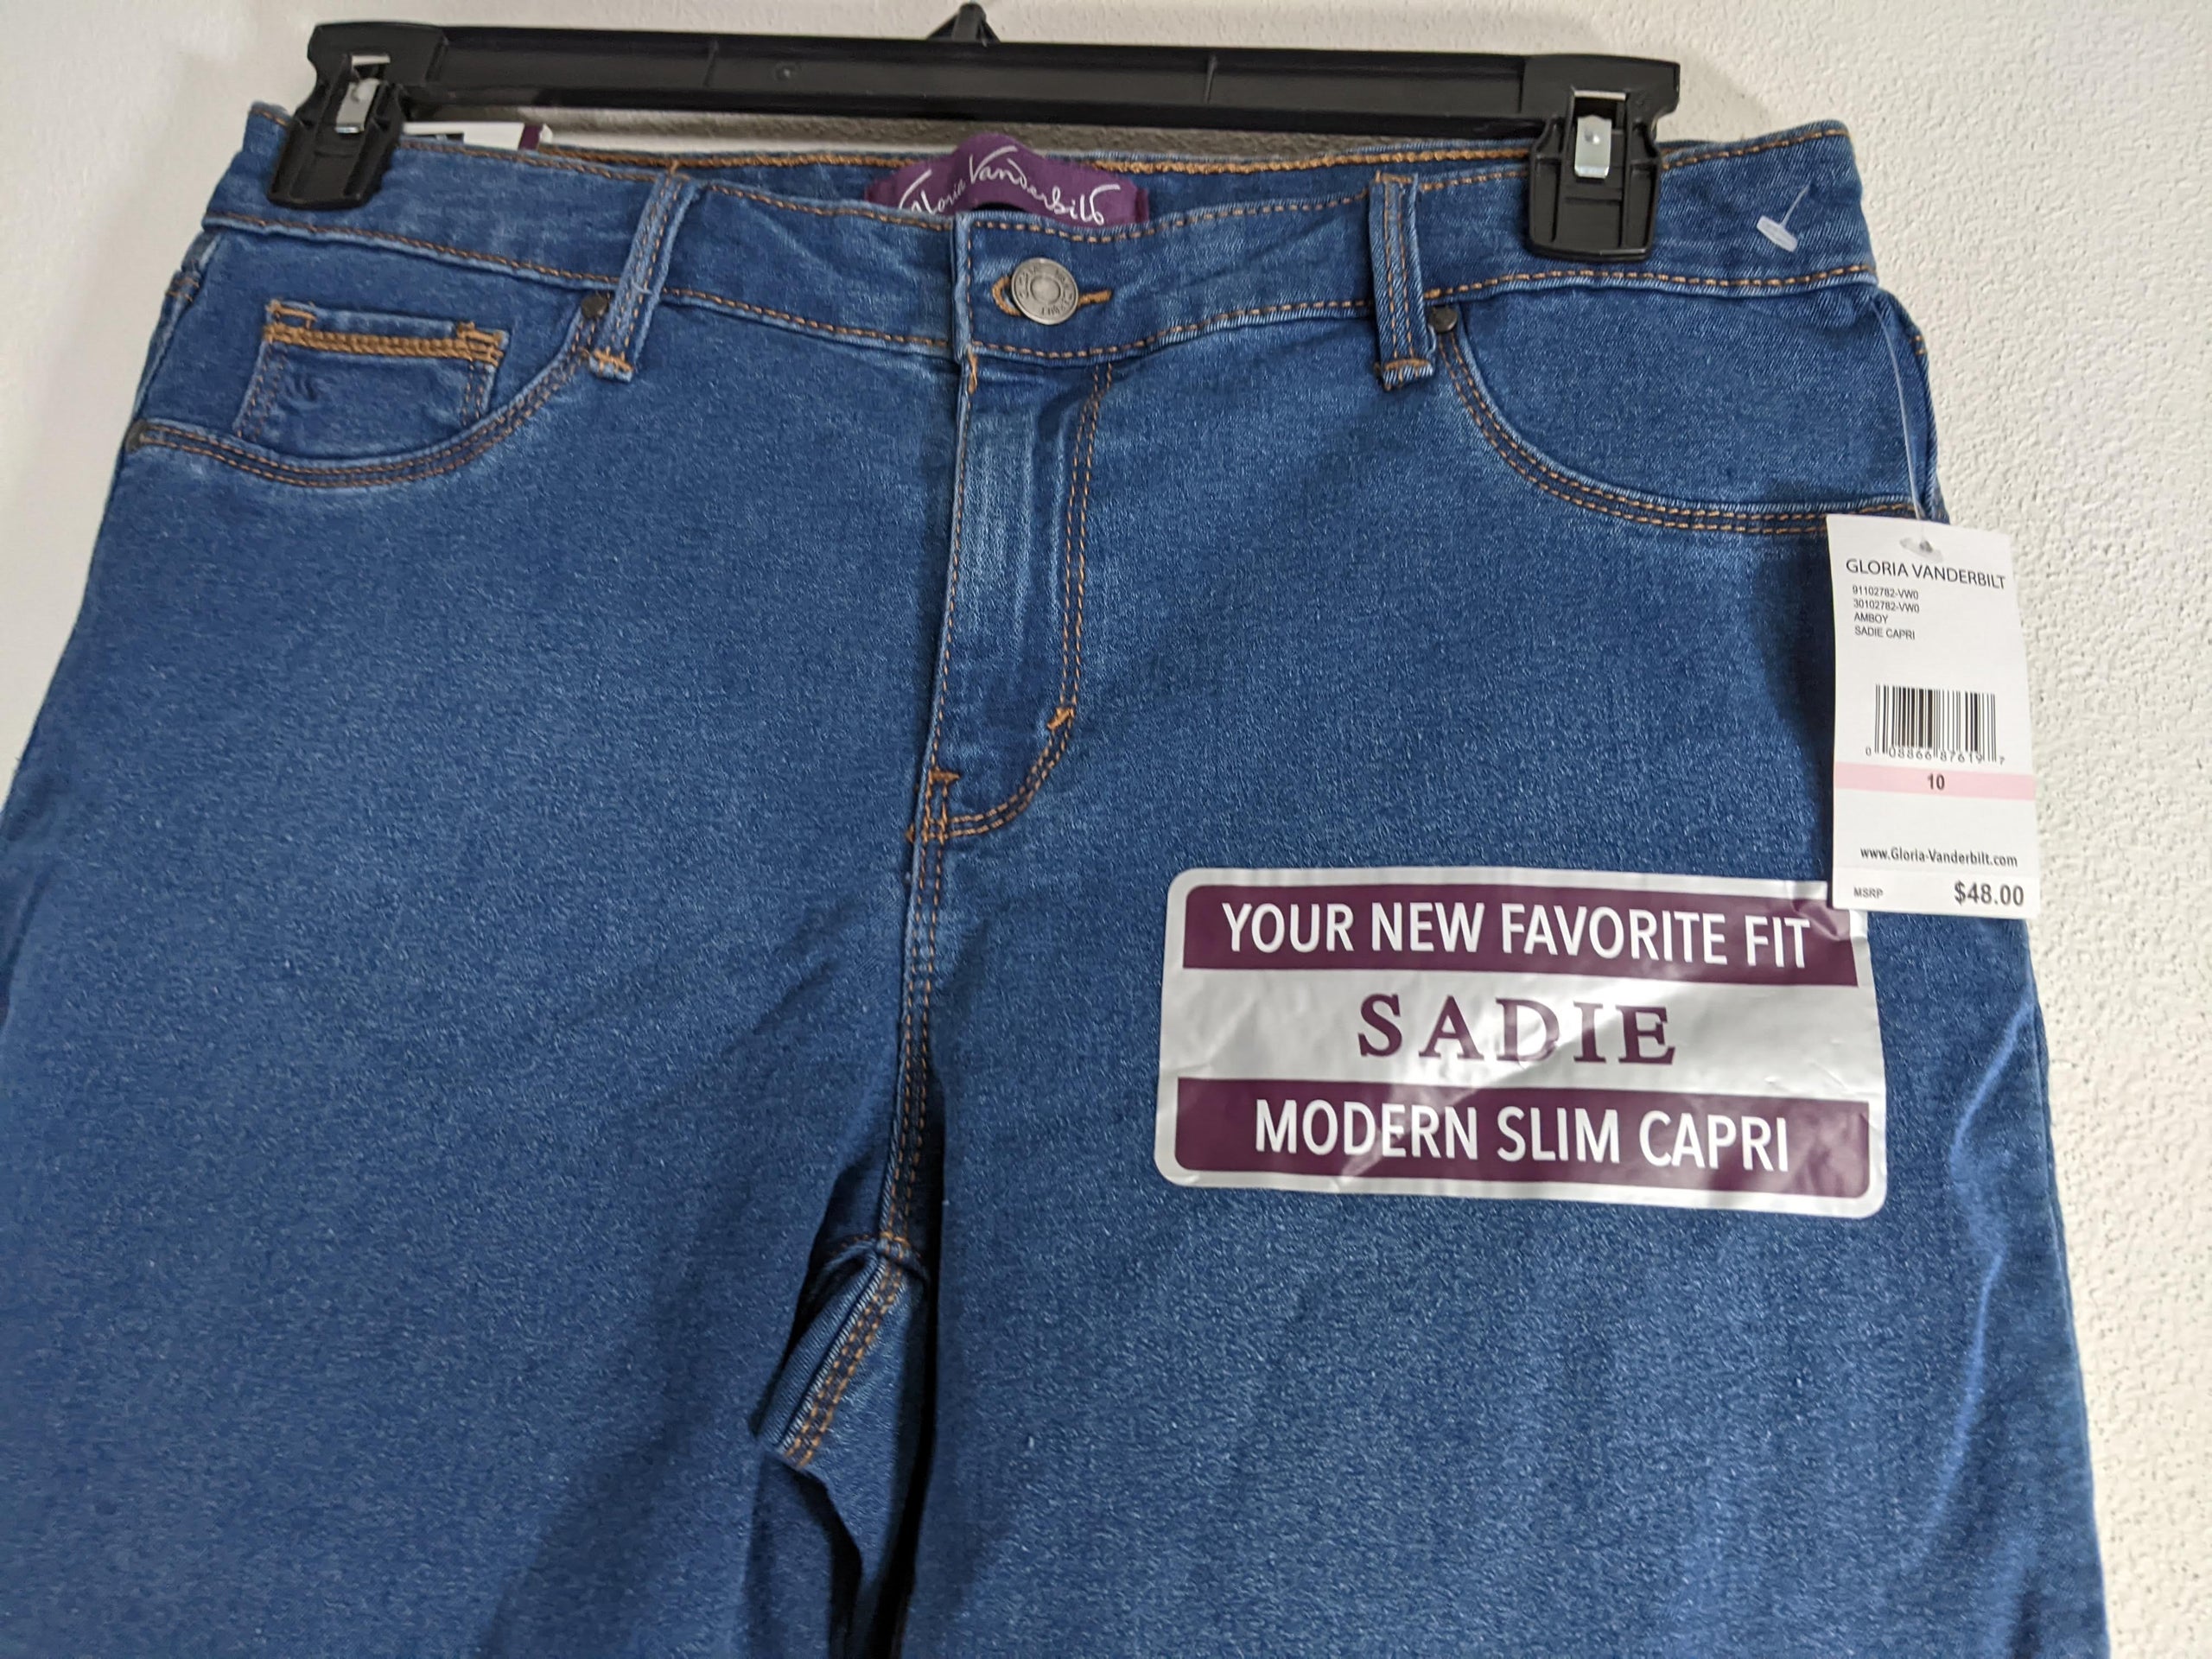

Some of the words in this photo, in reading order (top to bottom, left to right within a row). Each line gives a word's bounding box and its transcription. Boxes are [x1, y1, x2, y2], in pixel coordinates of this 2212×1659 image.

[1846, 558, 1908, 578] GLORIA
[1911, 563, 2006, 589] VANDERBILT
[1854, 612, 1889, 624] AMBOY
[1854, 626, 1884, 638] SADIE
[1885, 628, 1916, 640] CAPRI
[1927, 773, 1945, 790] 10
[1860, 847, 2018, 867] www.Gloria-Vanderbilt.com
[1853, 887, 1884, 899] MSRP
[1955, 880, 2024, 906] $48.00
[1223, 901, 1354, 954] YOUR
[1370, 902, 1486, 955] NEW
[1502, 903, 1728, 965] FAVORITE
[1745, 913, 1811, 969] FIT
[1357, 993, 1676, 1065] SADIE
[1254, 1098, 1479, 1161] MODERN
[1497, 1107, 1620, 1165] SLIM
[1639, 1110, 1789, 1173] CAPRI
